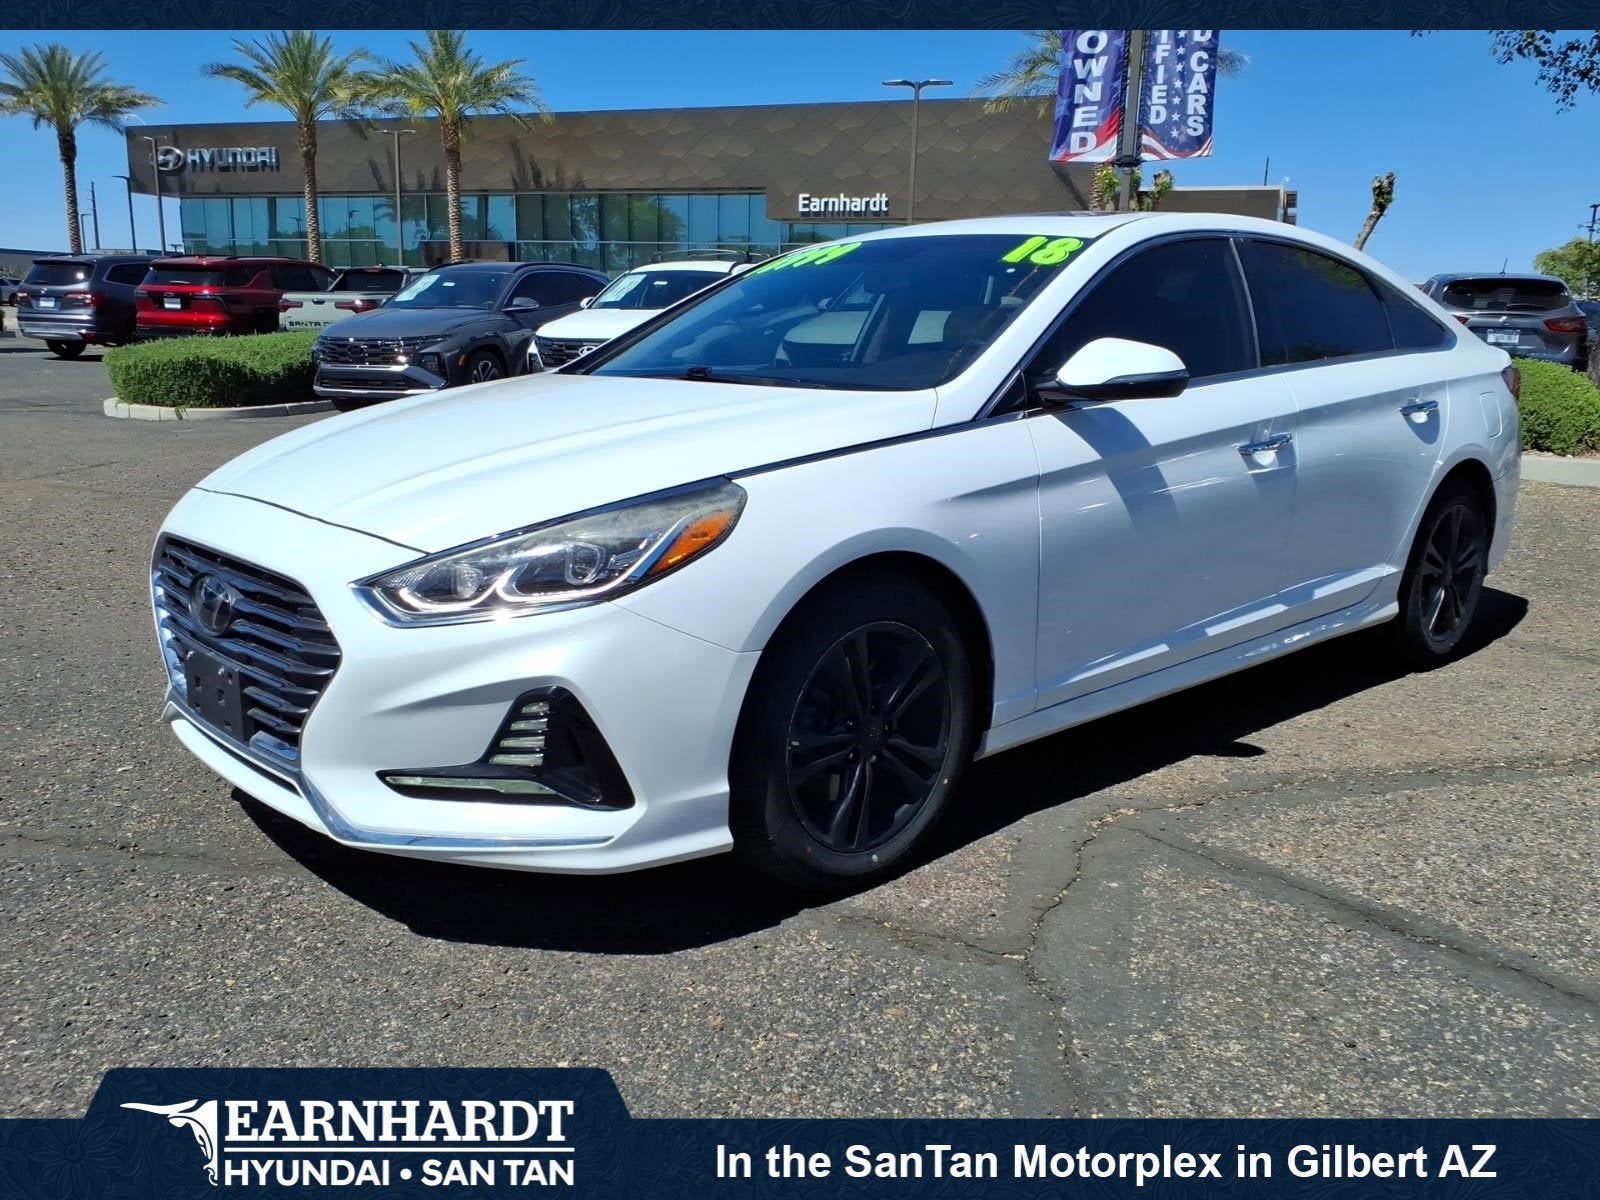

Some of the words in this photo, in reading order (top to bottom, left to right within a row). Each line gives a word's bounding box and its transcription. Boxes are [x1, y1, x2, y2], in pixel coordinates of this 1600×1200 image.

[1186, 51, 1209, 137] CARS
[186, 146, 277, 167] HYUNDAI
[798, 192, 889, 212] Earnhardt
[1001, 235, 1084, 265] 18
